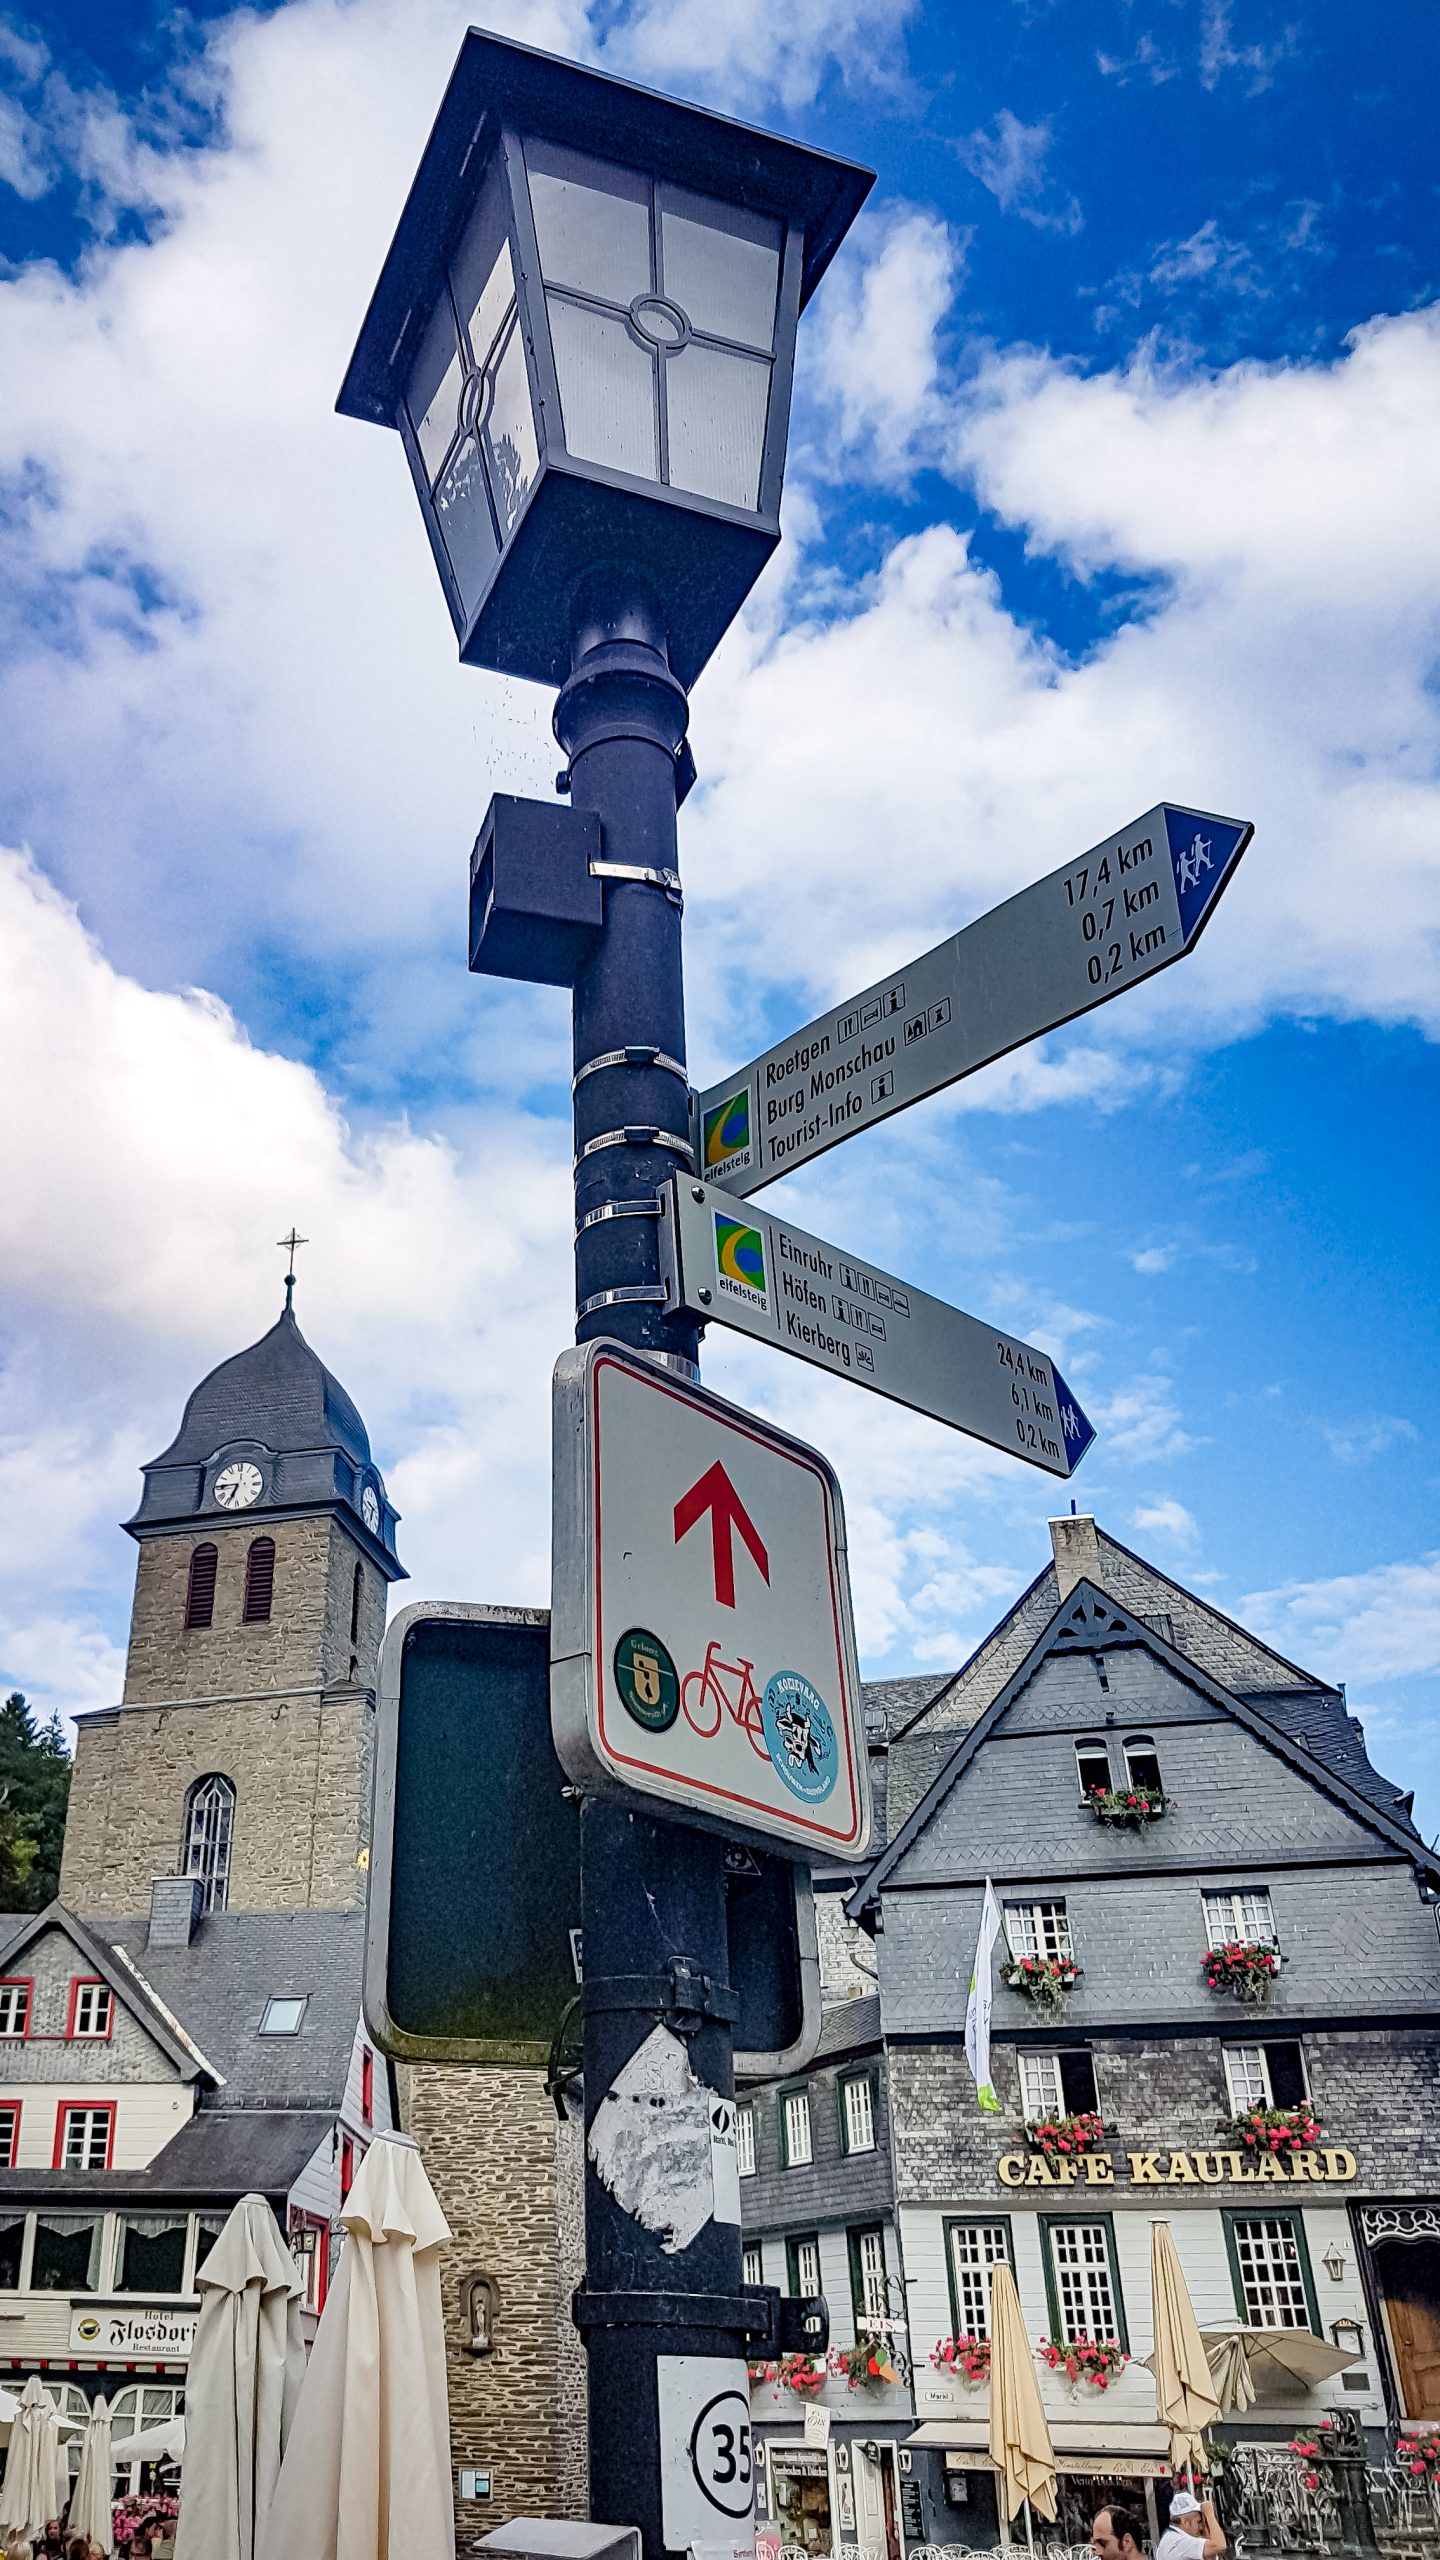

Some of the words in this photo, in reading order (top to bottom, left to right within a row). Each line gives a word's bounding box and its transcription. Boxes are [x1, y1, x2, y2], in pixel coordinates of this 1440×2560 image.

[1064, 858, 1110, 907] 17,4
[1117, 837, 1153, 872] km
[1083, 898, 1115, 943] 0,7
[1123, 879, 1160, 915] km
[1088, 942, 1123, 987] 0,2
[1130, 923, 1166, 960] km
[766, 1034, 830, 1089] Roetgen
[767, 1087, 805, 1126] Burg
[810, 1034, 896, 1099] Monschau
[769, 1094, 862, 1163] Tourist-Info
[704, 1151, 750, 1182] eifelsteig
[780, 1233, 834, 1280] Einruhr
[719, 1278, 768, 1311] eifelsteig
[782, 1270, 827, 1314] Höfen
[787, 1311, 851, 1368] Kierberg
[998, 1343, 1025, 1376] 24,4
[1026, 1356, 1048, 1387] km
[1011, 1384, 1030, 1412] 6,1
[1033, 1393, 1053, 1423] km
[1016, 1420, 1037, 1450] 0,2
[1040, 1429, 1060, 1459] km
[998, 2153, 1115, 2187] CAFE
[1127, 2147, 1357, 2185] KAULARD
[144, 2310, 174, 2320] Hotel
[869, 2318, 893, 2331] EIS
[132, 2343, 180, 2352] Restaurant
[711, 2423, 750, 2484] 35
